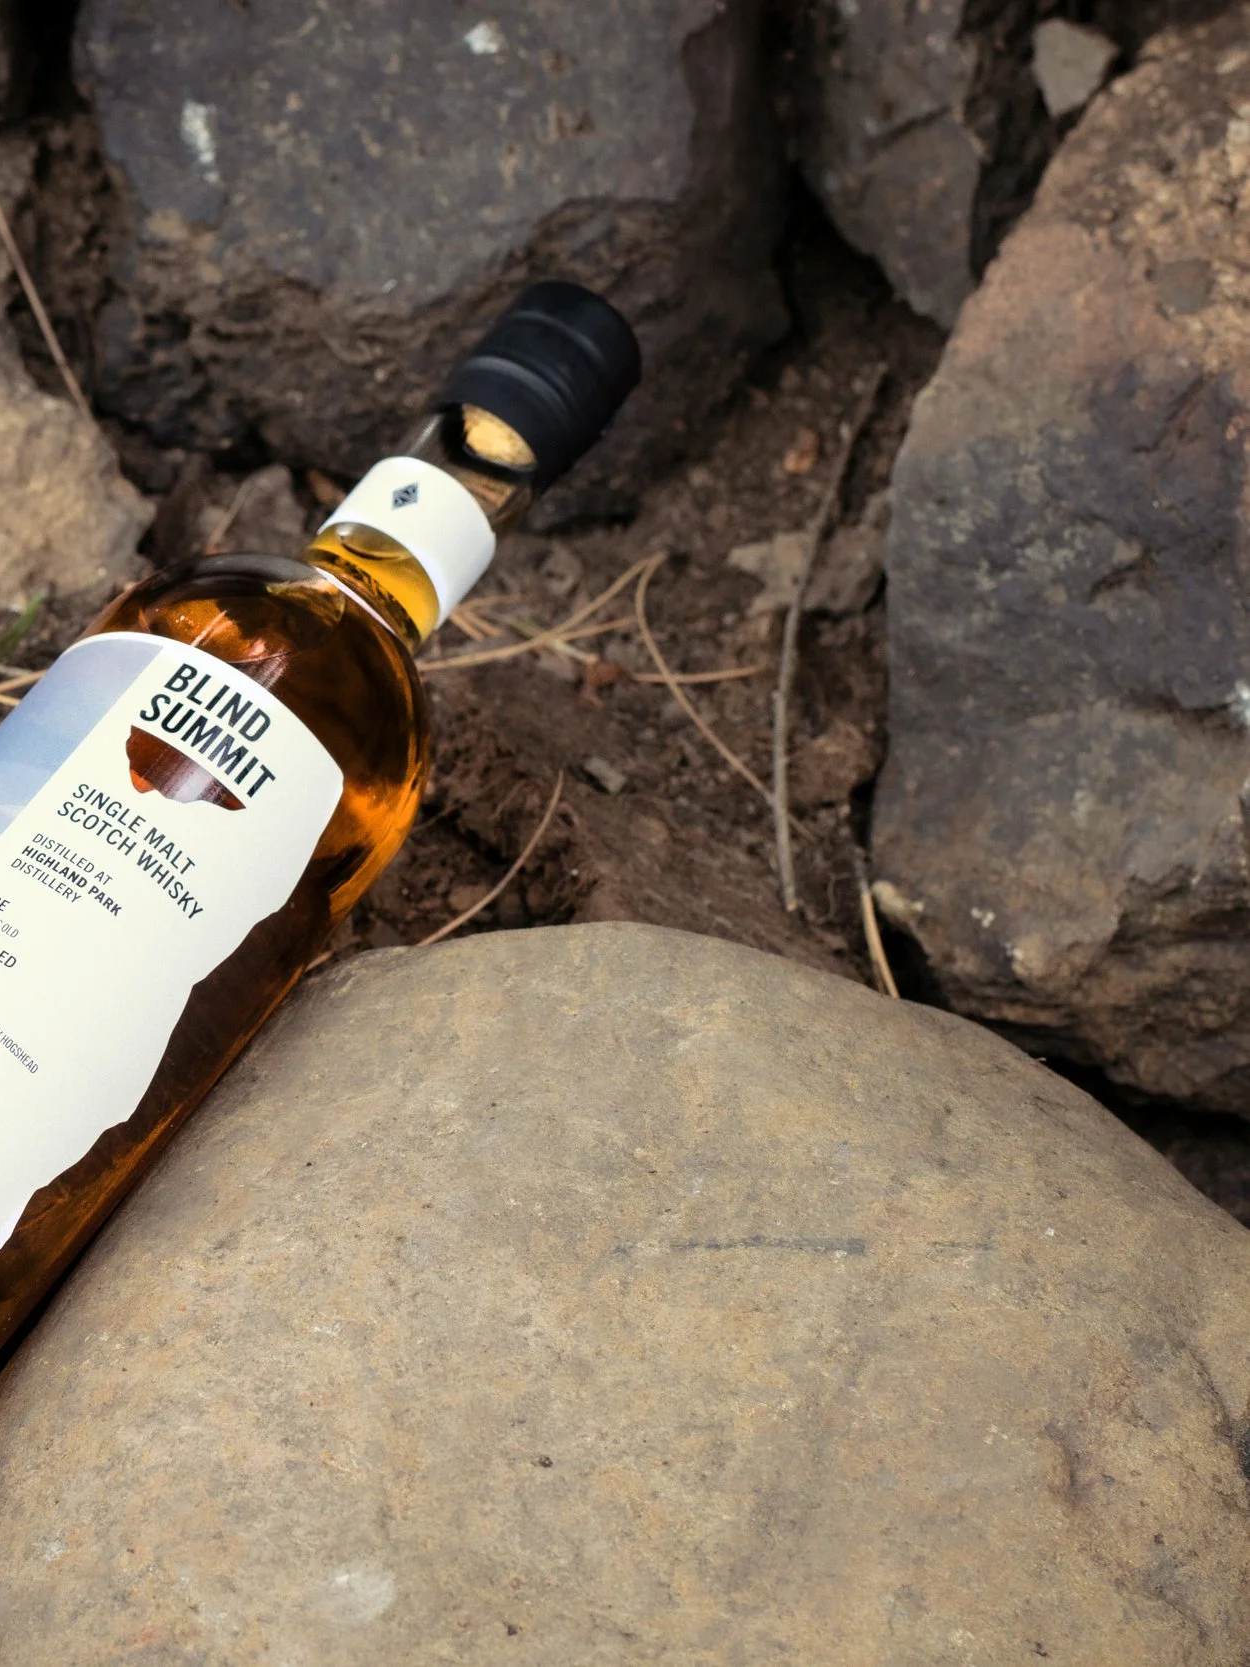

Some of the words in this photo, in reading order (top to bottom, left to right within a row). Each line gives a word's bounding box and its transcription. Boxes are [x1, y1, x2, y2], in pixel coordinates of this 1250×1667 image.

[164, 663, 271, 742] BLIND
[139, 693, 276, 798] SUMMIT
[32, 833, 96, 874] DISTILLED
[94, 870, 113, 886] AT
[57, 801, 137, 856] SCOTCH
[136, 849, 204, 920] WHISKY
[72, 783, 146, 834] SINGLE
[144, 826, 195, 875] MALT
[11, 858, 82, 904] DISTILLERY
[21, 846, 88, 888] HIGHLAND
[87, 885, 122, 917] PARK
[1, 923, 19, 938] OLD
[0, 1034, 39, 1074] HOGSHEAD
